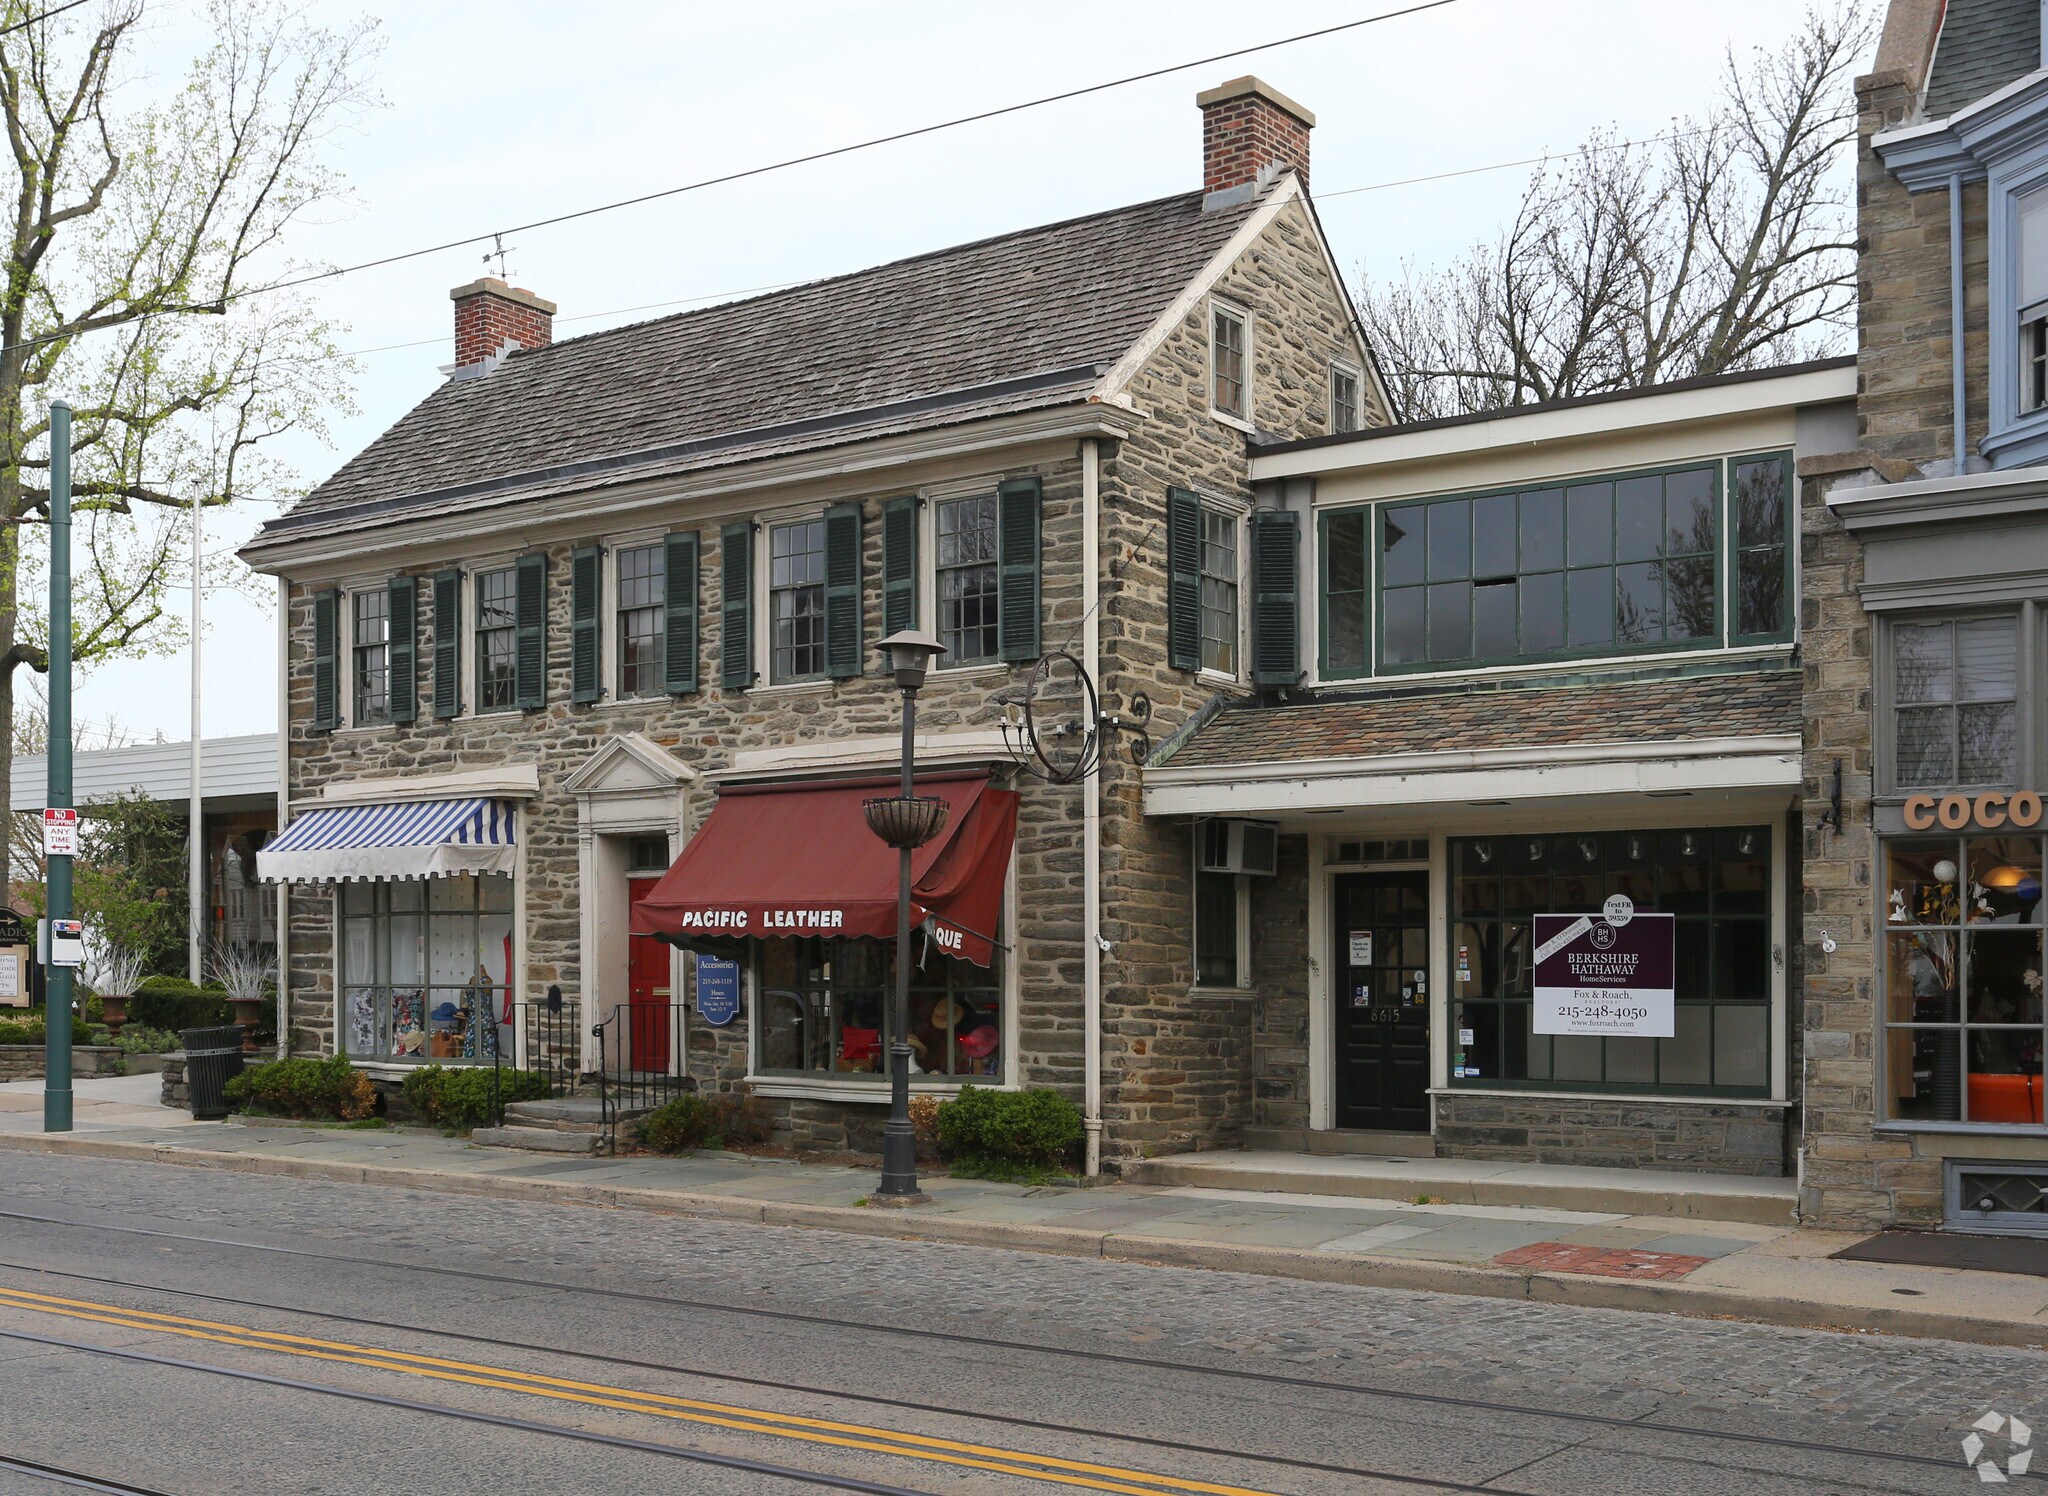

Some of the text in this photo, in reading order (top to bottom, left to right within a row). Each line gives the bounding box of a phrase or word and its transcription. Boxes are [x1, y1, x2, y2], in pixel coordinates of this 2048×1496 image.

[54, 810, 66, 819] NO
[1904, 790, 2042, 830] COCO
[682, 910, 843, 927] PACIFIC LEATHER
[934, 927, 963, 949] QUE
[1568, 953, 1639, 964] BERKSHIRE
[700, 961, 734, 969] Accessories
[1571, 965, 1636, 975] HATHAWAY
[1580, 975, 1627, 983] HomeServices
[1574, 990, 1632, 1000] Fox & Roach,
[1371, 1008, 1400, 1023] 8615
[1558, 1005, 1647, 1019] 215-248-4050
